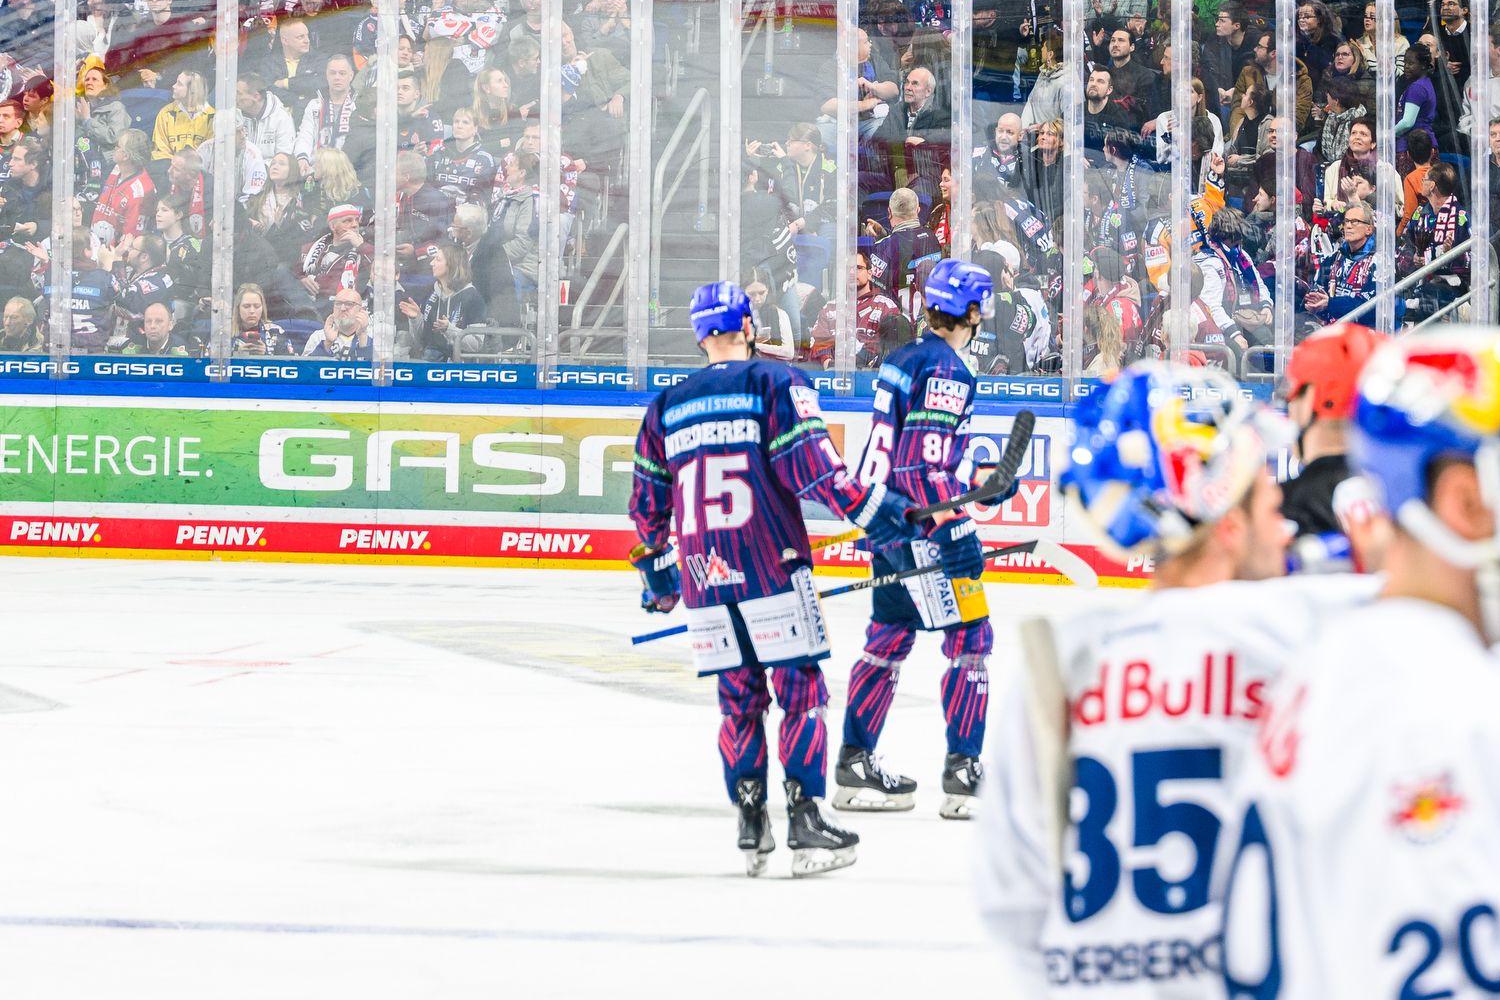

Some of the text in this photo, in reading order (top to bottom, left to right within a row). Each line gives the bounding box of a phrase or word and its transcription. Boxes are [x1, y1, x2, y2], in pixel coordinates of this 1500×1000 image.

[94, 362, 183, 376] GASAG
[204, 364, 298, 379] GASAG
[320, 367, 413, 381] GASAG
[427, 369, 517, 384] GASAG
[539, 371, 633, 386] GASAG
[976, 382, 1061, 397] GASAG
[259, 427, 636, 498] GASA
[678, 454, 753, 536] 15
